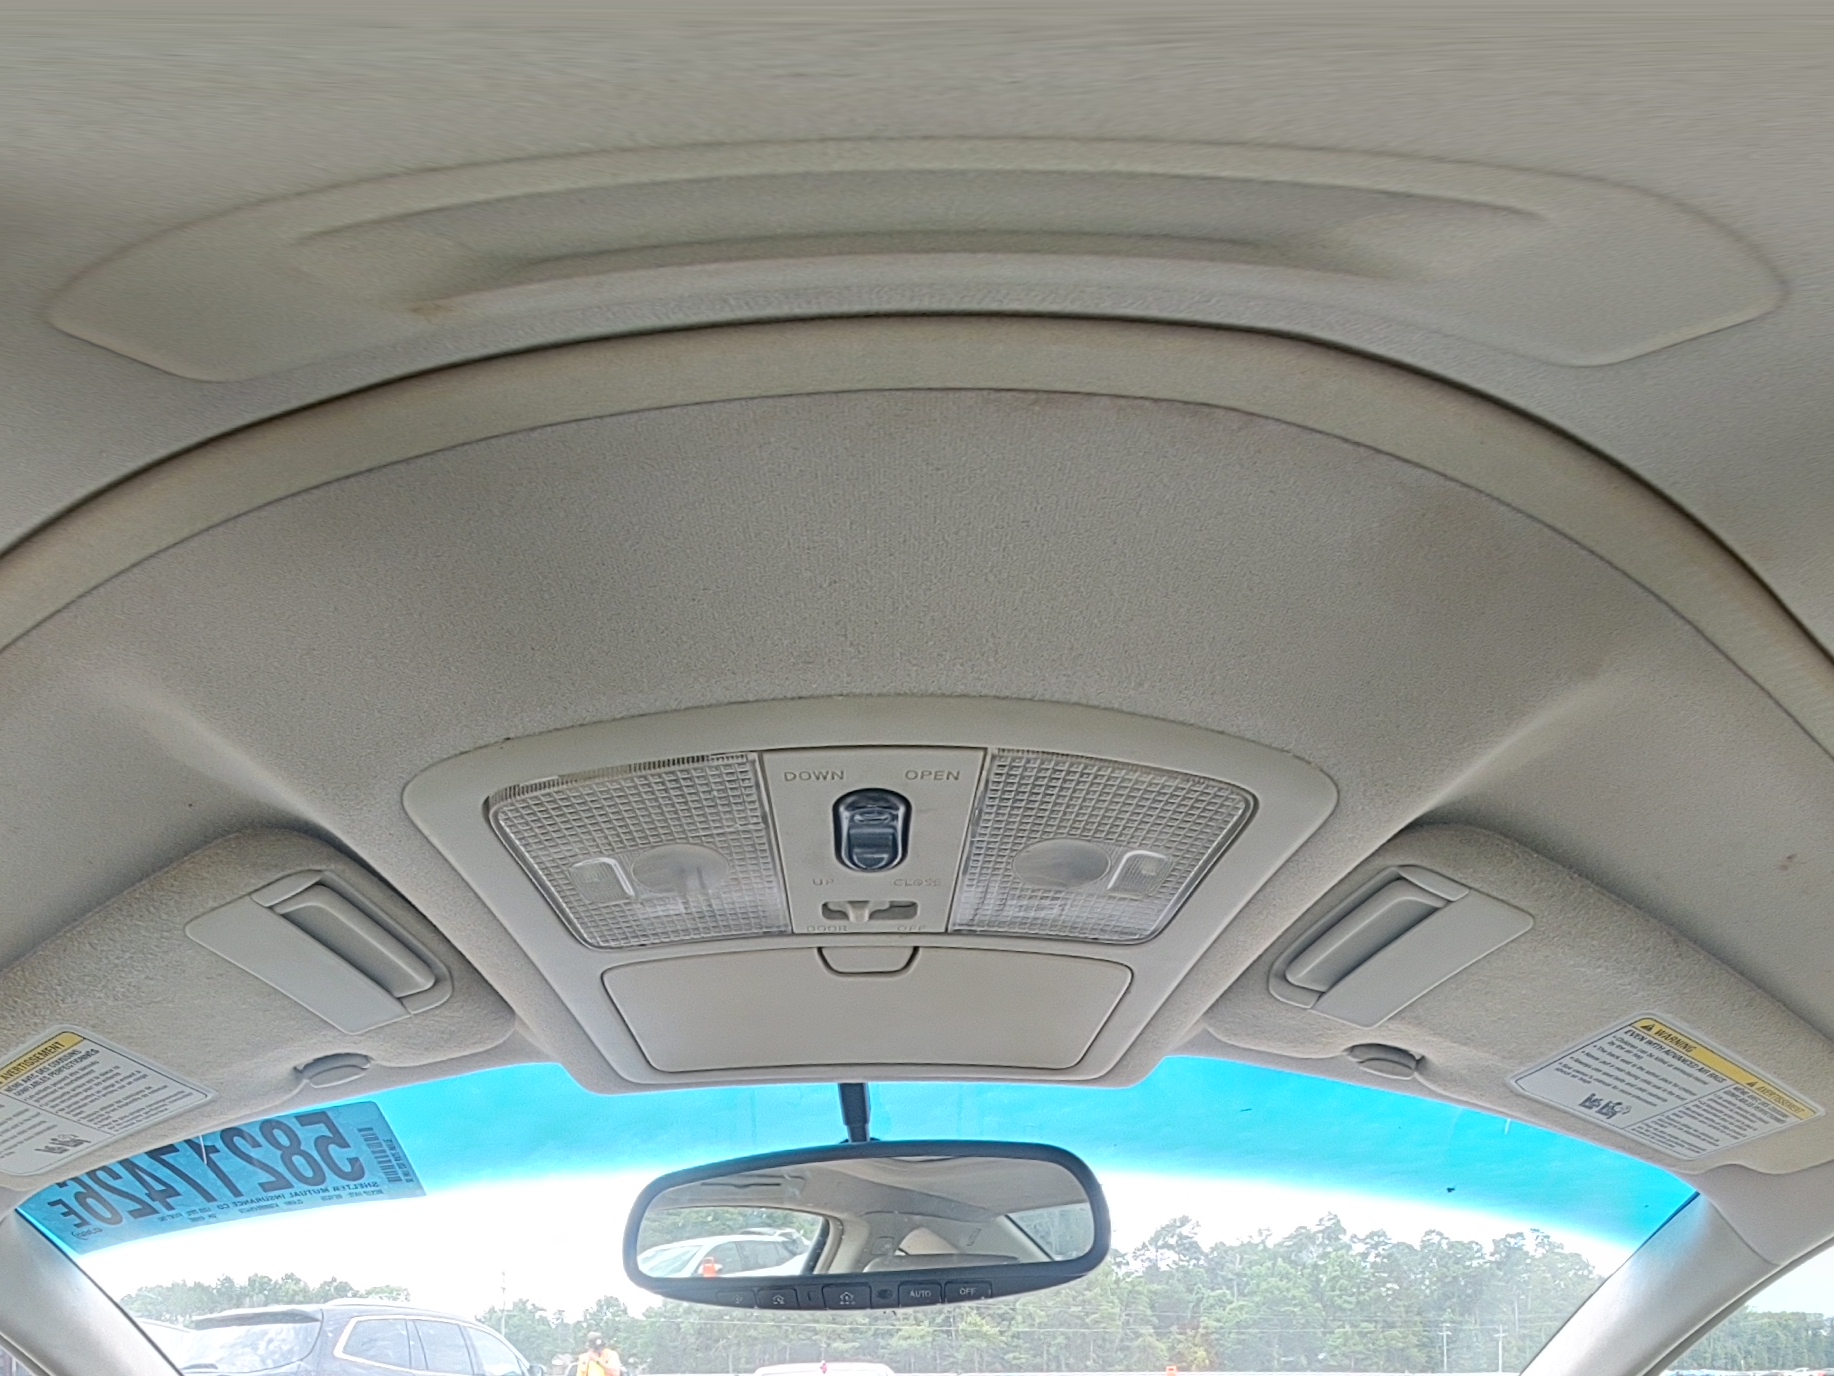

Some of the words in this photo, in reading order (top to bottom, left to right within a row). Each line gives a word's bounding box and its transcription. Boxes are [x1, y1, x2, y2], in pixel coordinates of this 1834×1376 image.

[784, 770, 845, 782] DOWN
[905, 770, 961, 781] OPEN
[812, 878, 835, 886] UP
[893, 878, 941, 887] CLOSE
[1652, 1029, 1698, 1053] WARNING
[910, 1290, 931, 1298] AUTO
[959, 1287, 976, 1296] OFF
